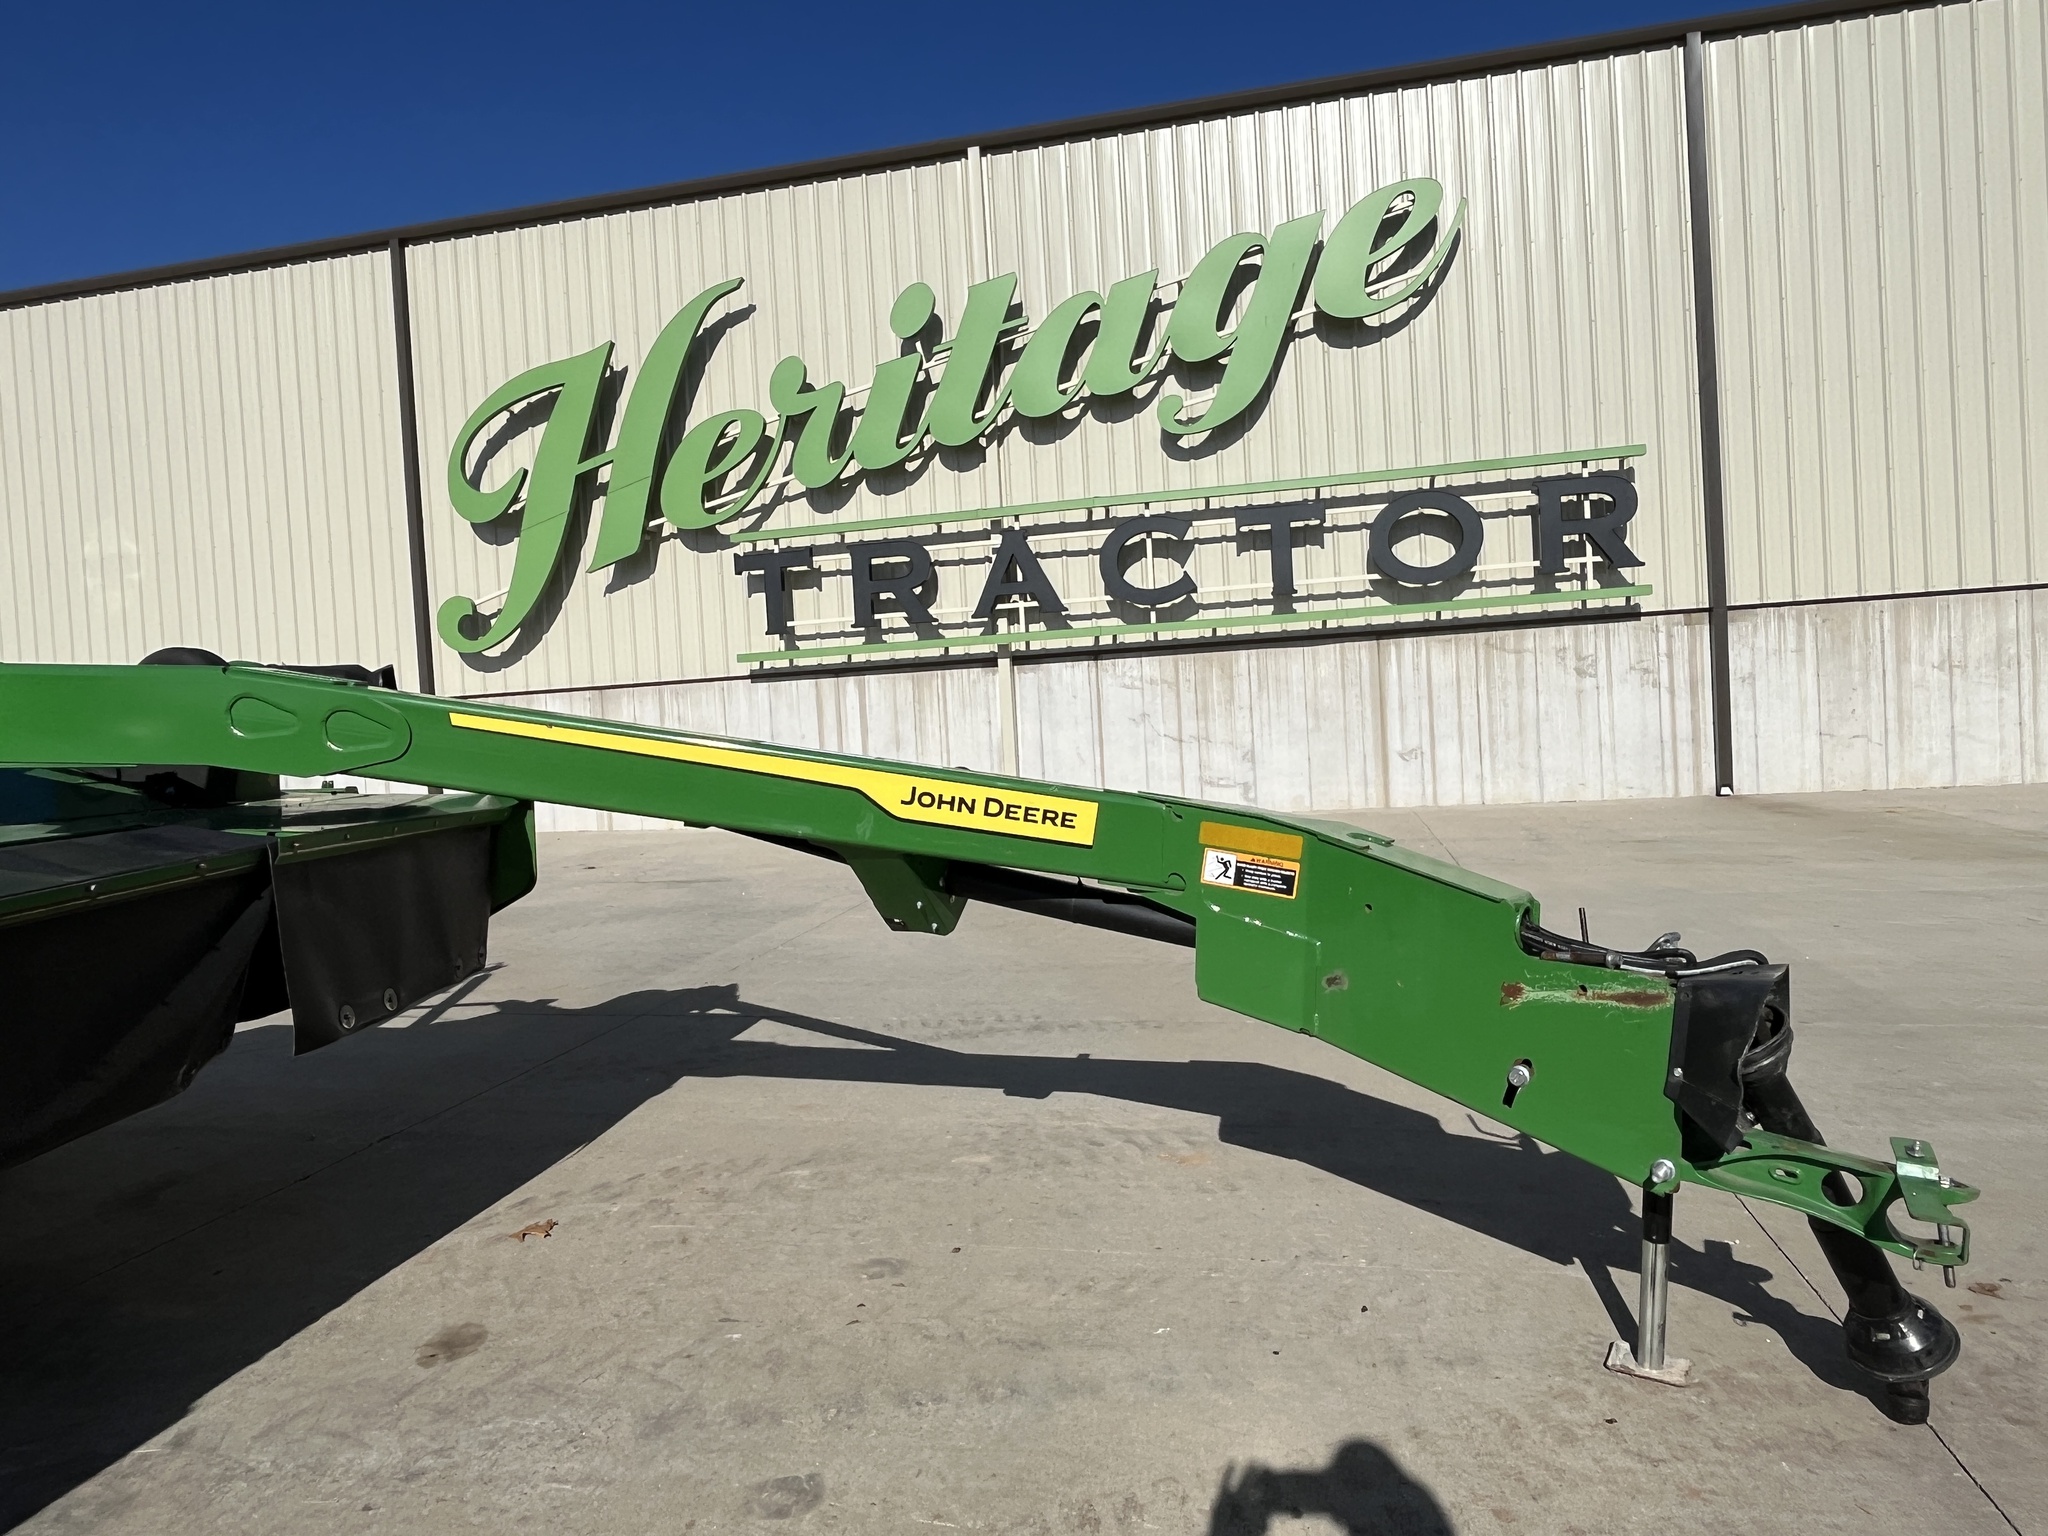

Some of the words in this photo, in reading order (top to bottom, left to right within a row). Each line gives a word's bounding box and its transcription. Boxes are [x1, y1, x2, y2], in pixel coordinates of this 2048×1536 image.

[437, 177, 1467, 653] Heritage
[734, 475, 1646, 635] TRACTOR
[900, 786, 976, 814] JOHN
[983, 797, 1078, 829] DEERE
